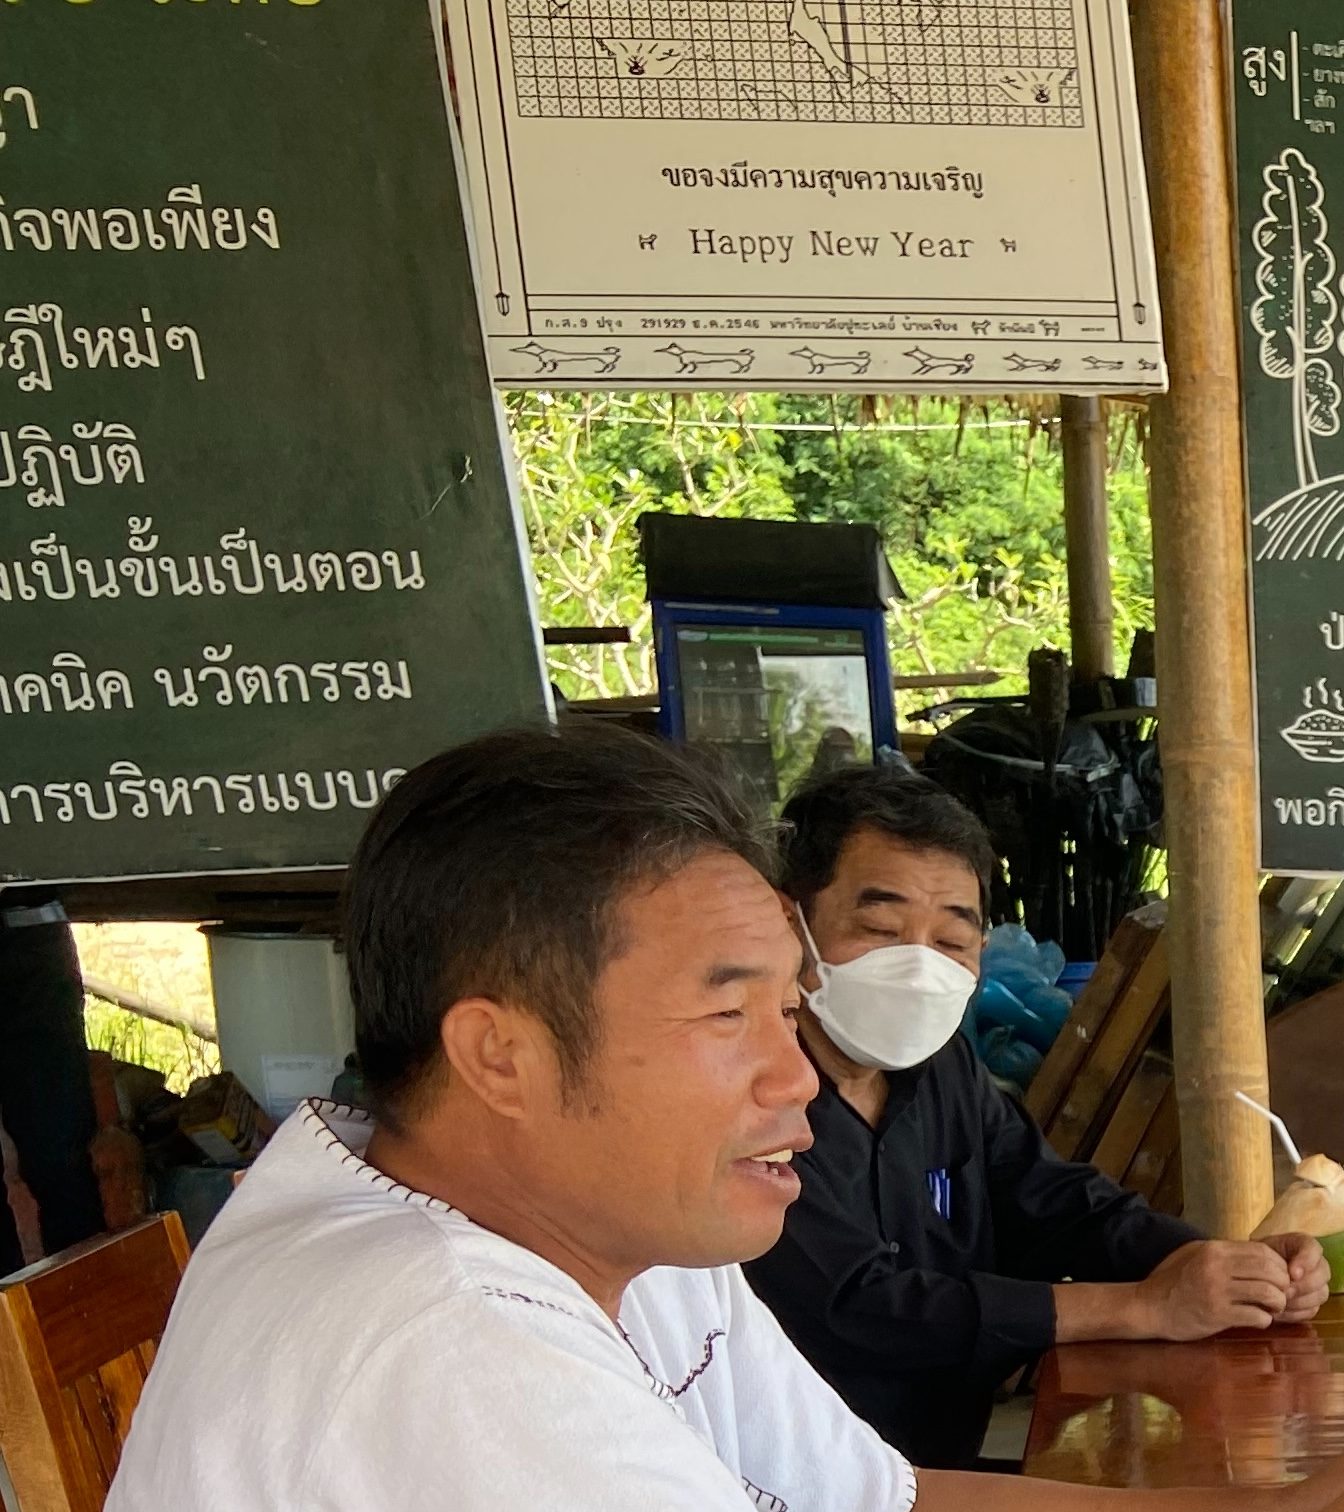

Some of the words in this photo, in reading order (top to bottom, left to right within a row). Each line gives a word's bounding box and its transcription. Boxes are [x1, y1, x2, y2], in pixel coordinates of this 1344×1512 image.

[1242, 47, 1286, 96] สูง
[661, 162, 983, 199] ขอจงมีความสุขความเจริญ
[691, 229, 794, 263] Happy
[810, 231, 880, 258] New
[891, 232, 975, 260] Year
[154, 645, 413, 708] นวัตกรรม
